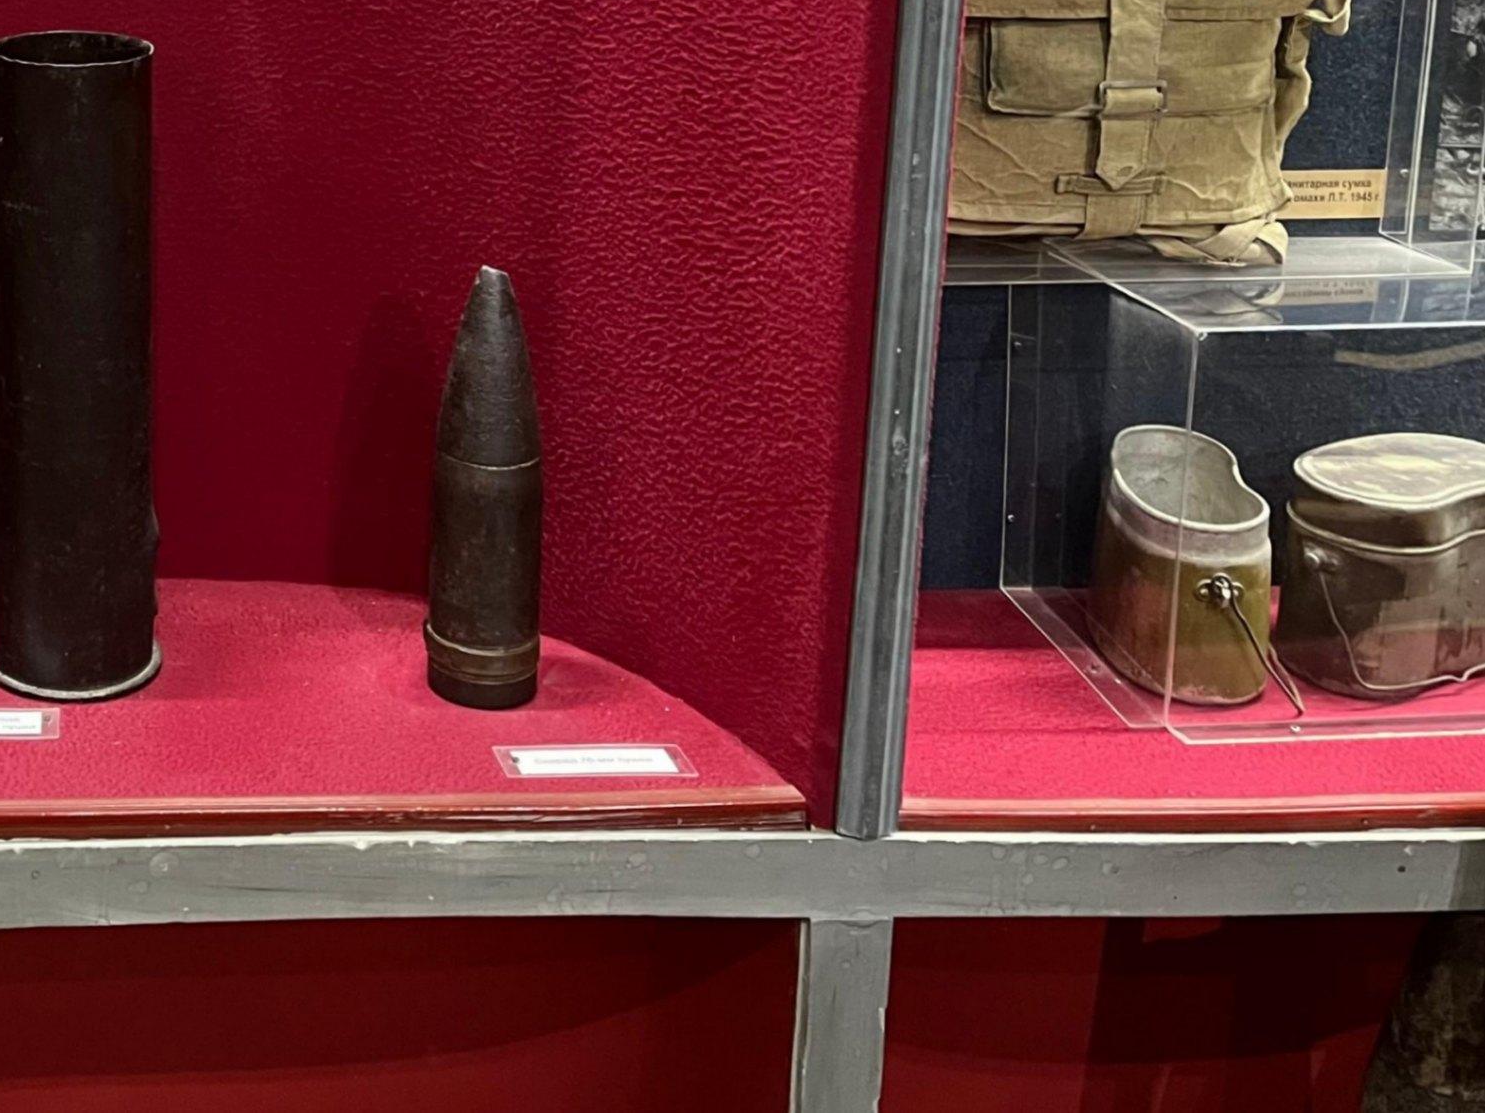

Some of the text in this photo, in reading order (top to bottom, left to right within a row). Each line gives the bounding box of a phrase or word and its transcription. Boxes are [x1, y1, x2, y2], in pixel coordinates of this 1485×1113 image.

[1287, 179, 1372, 191] анитарная сумка
[1293, 194, 1326, 202] омахи
[1350, 192, 1372, 202] 1945
